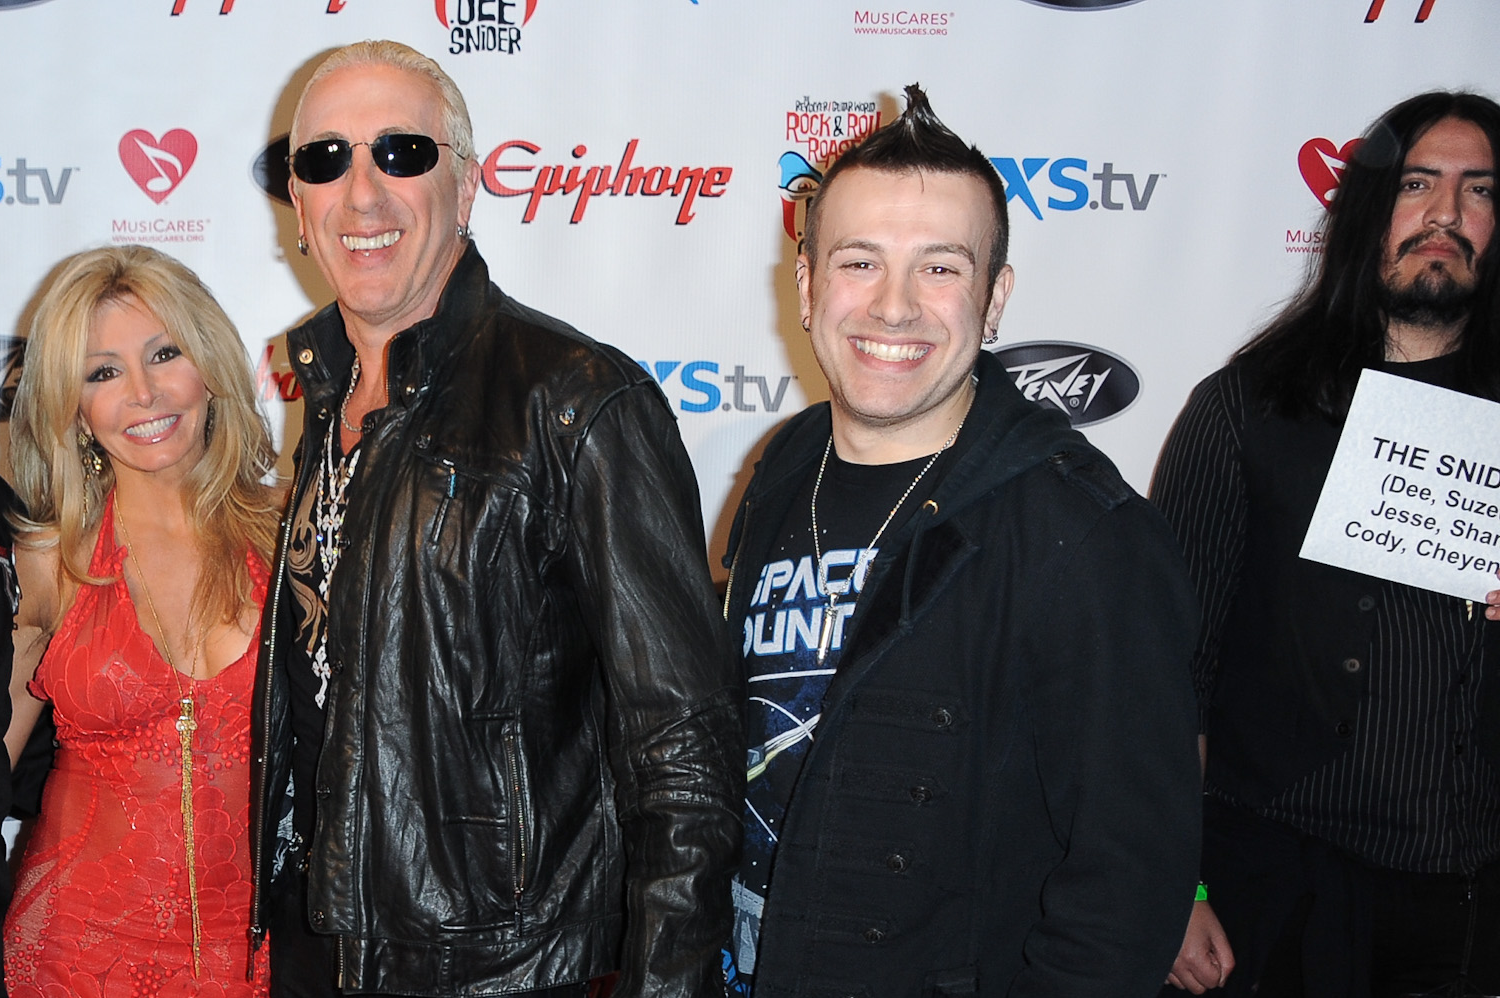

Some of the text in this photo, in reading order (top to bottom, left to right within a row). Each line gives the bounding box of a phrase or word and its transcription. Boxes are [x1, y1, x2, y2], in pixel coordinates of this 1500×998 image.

[786, 112, 831, 142] ROCK
[833, 115, 844, 137] &
[481, 138, 733, 225] Epiphone
[1373, 436, 1430, 471] THE
[1381, 473, 1500, 519] (Dee, Suze
[1370, 500, 1442, 535] Jesse,
[1345, 521, 1407, 555] Cody,
